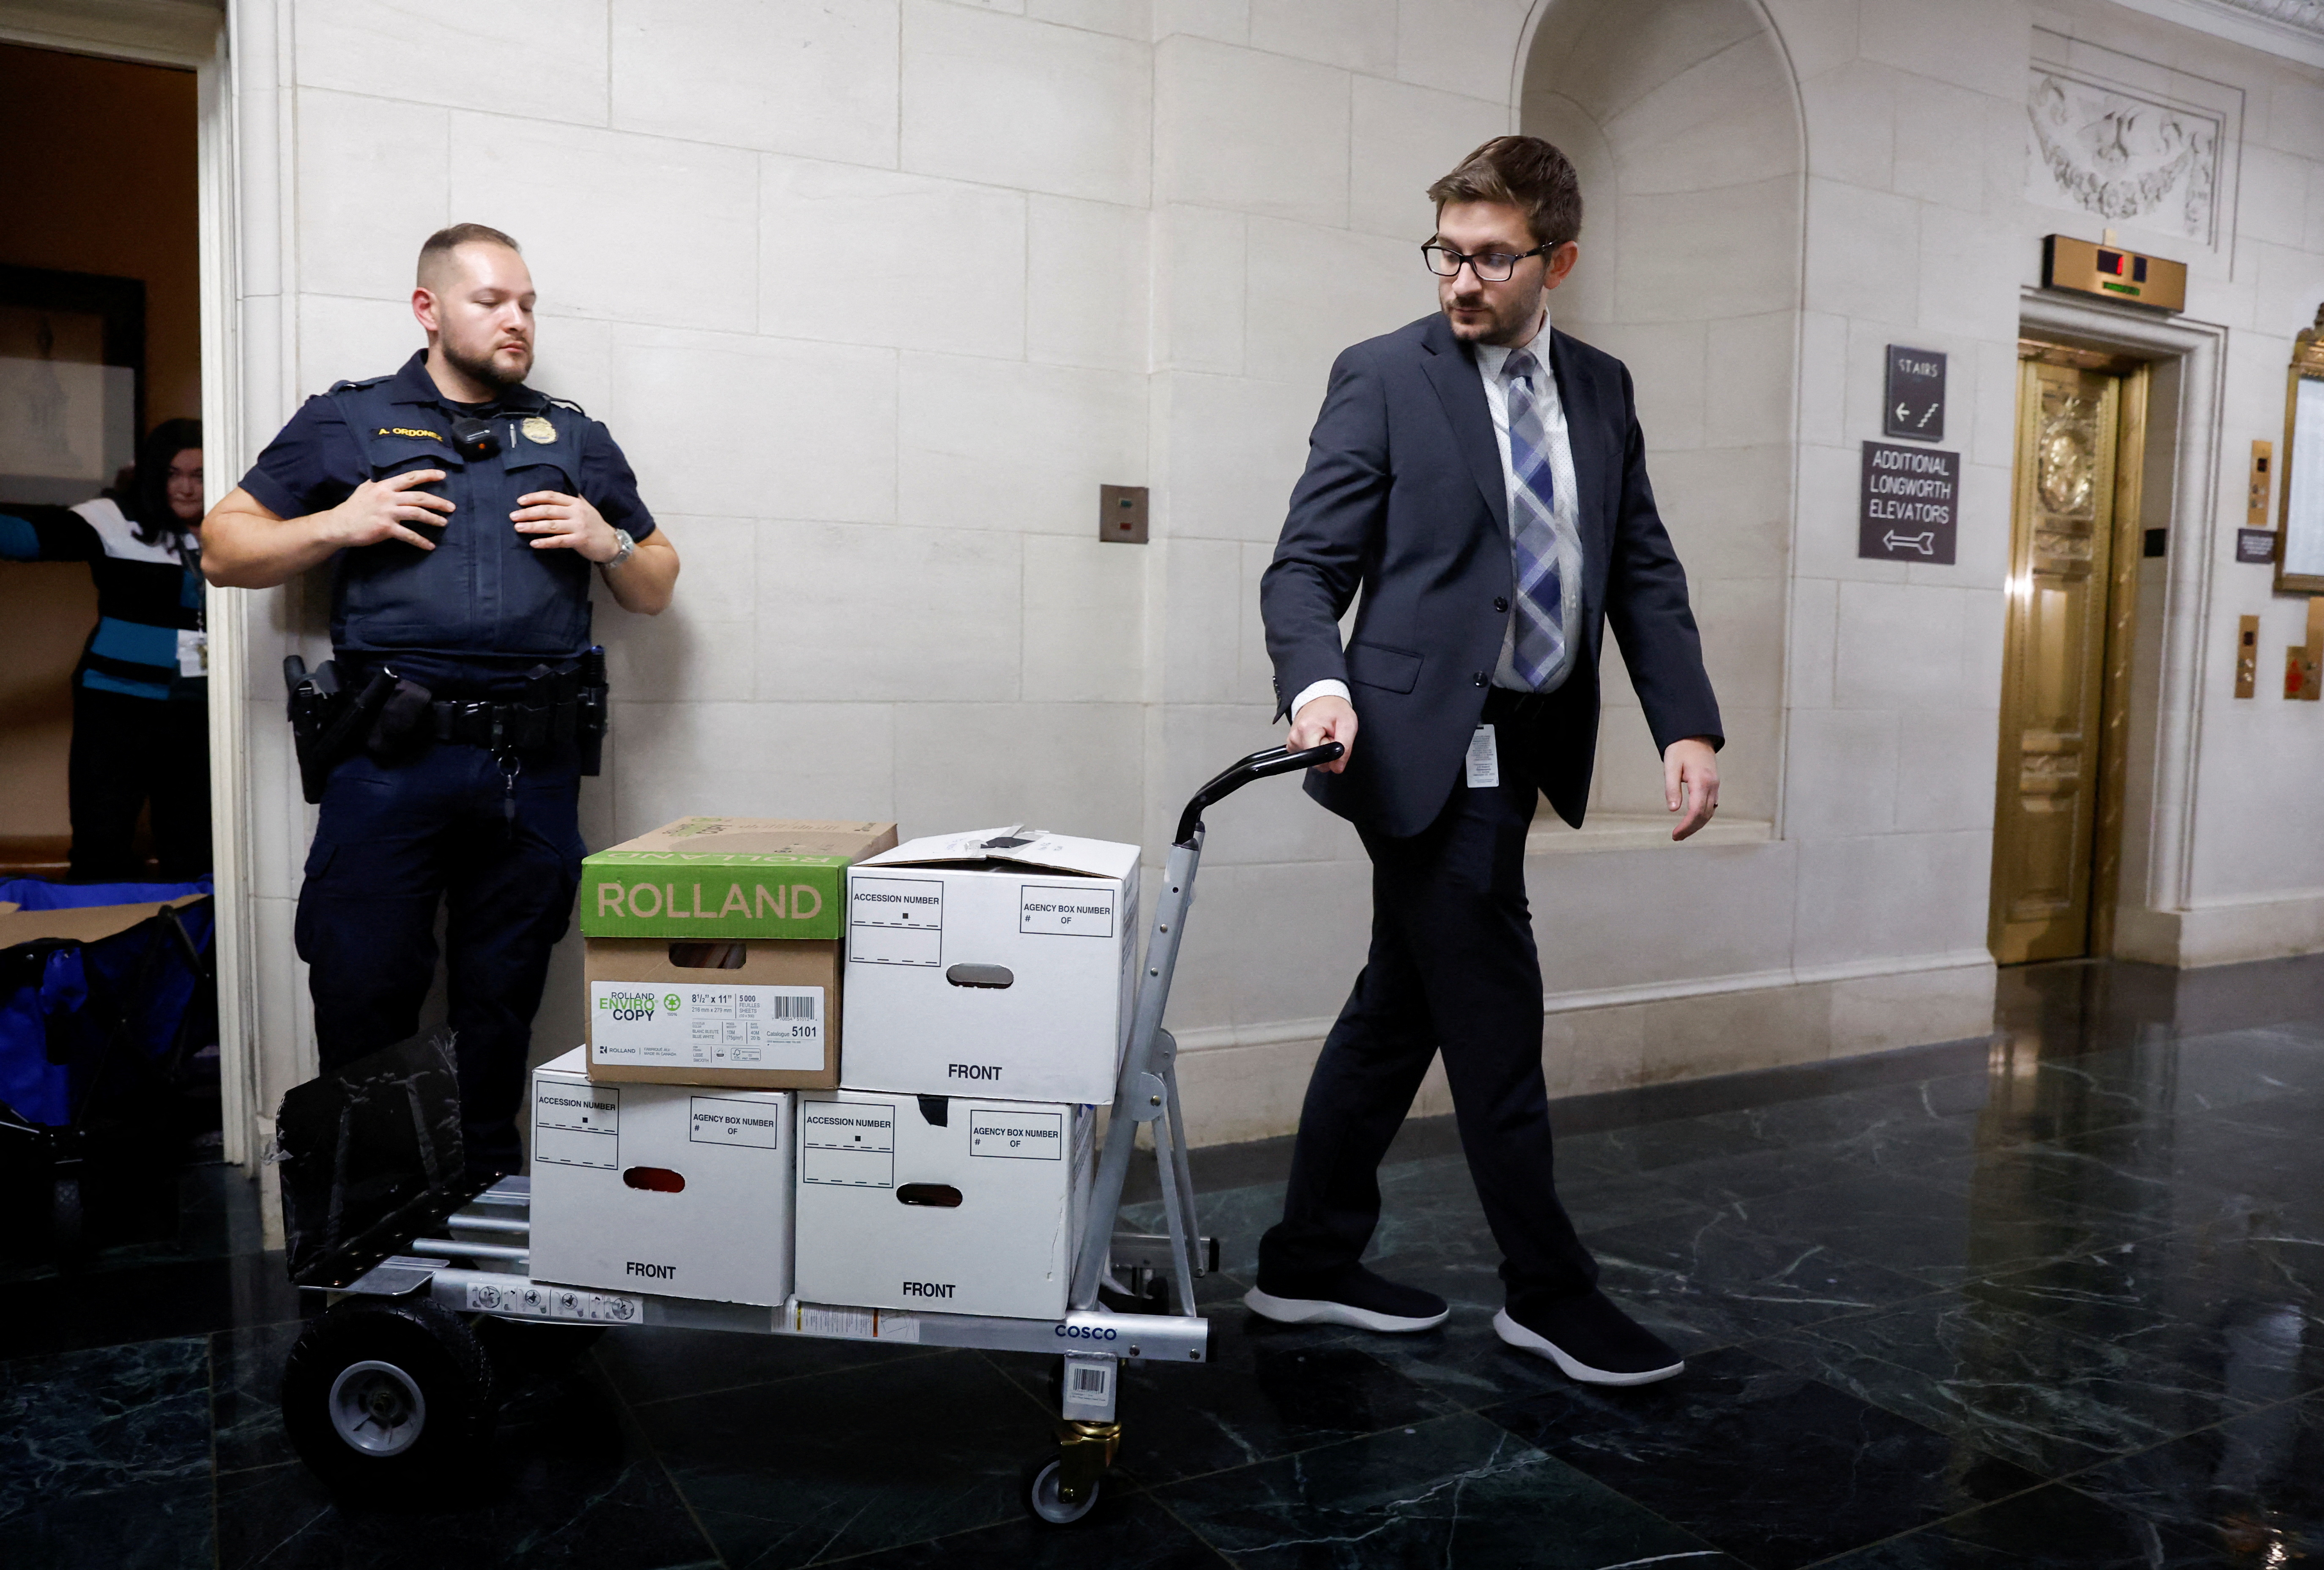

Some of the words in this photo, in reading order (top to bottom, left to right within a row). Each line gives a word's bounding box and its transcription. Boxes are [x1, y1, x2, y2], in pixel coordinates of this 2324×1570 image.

[1898, 359, 1938, 377] STAIRS
[1872, 450, 1949, 476] ADDITIONAL
[1870, 474, 1952, 499] LONGWORTH
[1869, 499, 1949, 524] ELEVATORS
[608, 853, 830, 863] ROLLAND
[598, 883, 822, 919] ROLLAND
[854, 893, 901, 903] ACCESSION
[903, 896, 939, 904] NUMBER
[1024, 903, 1057, 912] AGENCY
[1076, 906, 1110, 914] NUMBER
[613, 1009, 654, 1021] COPY
[792, 1026, 816, 1037] 5101
[948, 1064, 1003, 1080] FRONT
[539, 1096, 582, 1108] ACCESSION
[583, 1102, 616, 1110] NUMBER
[693, 1113, 724, 1123] AGENCY
[725, 1116, 741, 1124] BOX
[742, 1118, 774, 1127] NUMBER
[807, 1116, 854, 1126] ACCESSION
[856, 1119, 891, 1128] NUMBER
[973, 1127, 1006, 1136] AGENCY
[1025, 1130, 1059, 1138] NUMBER
[627, 1261, 676, 1279] FRONT
[903, 1282, 956, 1298] FRONT
[1055, 1324, 1117, 1340] COSCO
